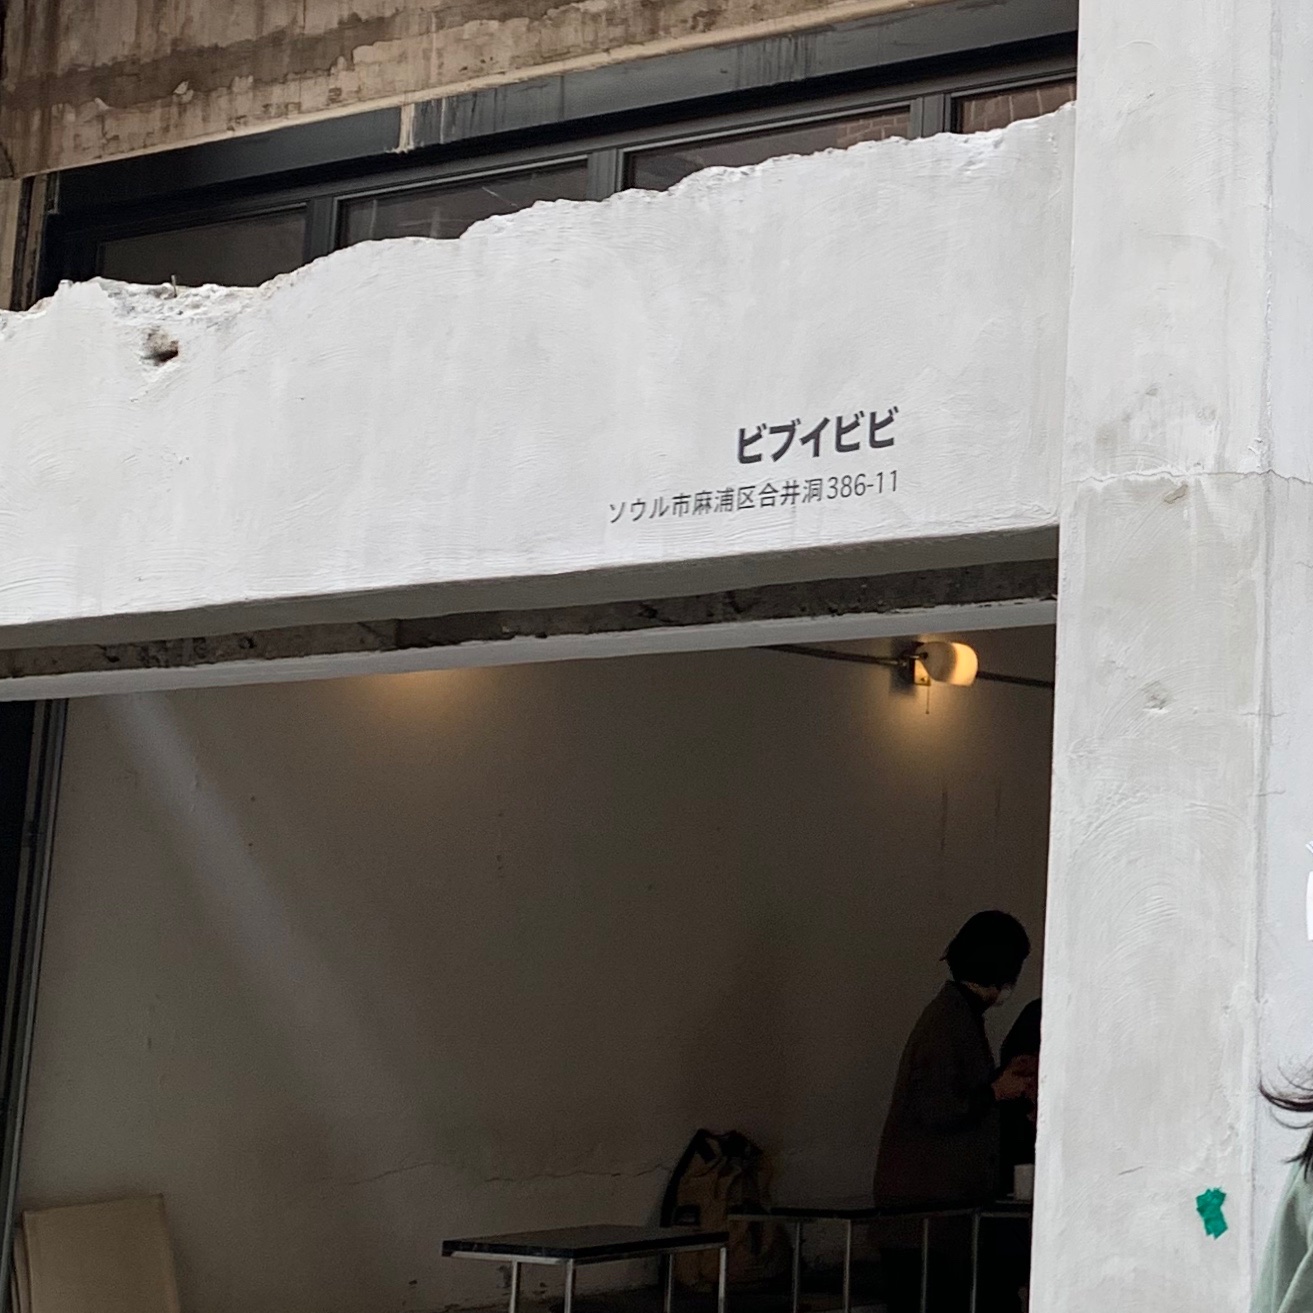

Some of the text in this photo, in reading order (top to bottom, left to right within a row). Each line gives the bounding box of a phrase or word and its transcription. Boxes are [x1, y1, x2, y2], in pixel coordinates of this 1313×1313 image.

[738, 406, 899, 464] ビブイビビ
